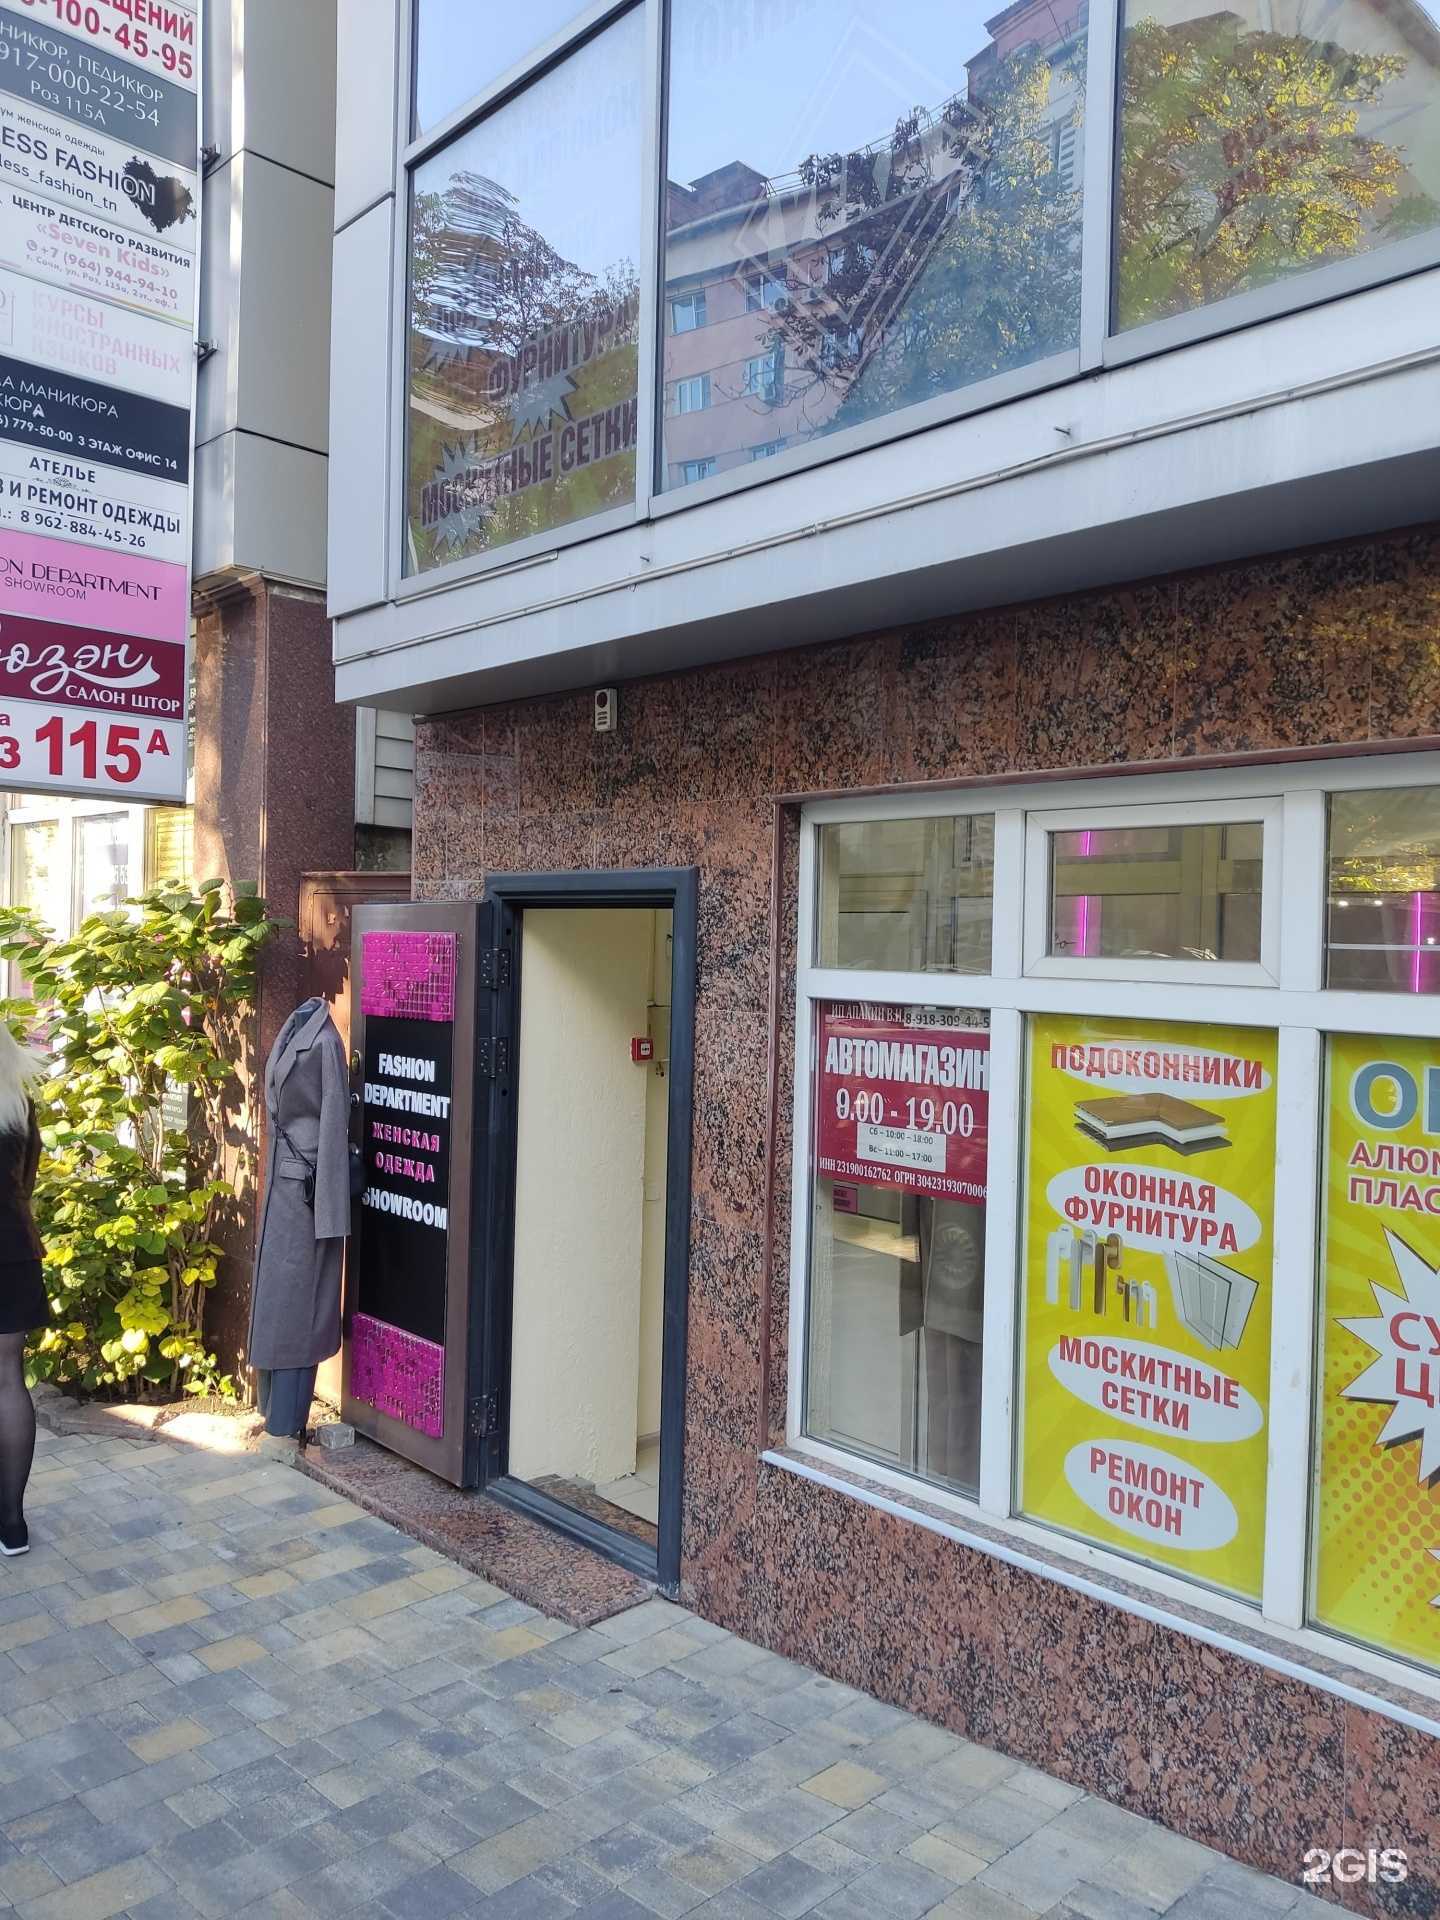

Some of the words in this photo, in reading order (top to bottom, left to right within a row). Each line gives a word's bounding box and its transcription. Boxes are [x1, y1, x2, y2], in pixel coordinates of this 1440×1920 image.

[22, 0, 192, 79] -100-45-95
[104, 0, 193, 45] ЩЕНИЙ
[79, 55, 163, 102] ПЕДИКЮР
[31, 80, 60, 104] Роз
[66, 96, 106, 125] 115А
[17, 114, 61, 137] женской
[65, 134, 105, 156] одежды
[55, 147, 156, 205] FASHION
[12, 194, 56, 218] ЦЕНТР
[59, 213, 125, 245] ДЕТСКОГО
[128, 238, 190, 269] РАЗВИТИЯ
[20, 380, 119, 419] МАНИКЮРА
[12, 417, 73, 442] 779-50-00
[78, 435, 86, 447] 3
[88, 438, 122, 456] ЭТАЖ
[125, 448, 162, 466] ОФИС
[164, 456, 178, 470] 14
[560, 397, 637, 474] СЕТКИ
[29, 456, 97, 484] АТЕЛЬЕ
[10, 480, 21, 498] И
[27, 484, 98, 515] РЕМОНТ
[102, 502, 181, 534] ОДЕЖДЫ
[20, 510, 30, 523] 8
[35, 512, 146, 548] 962-884-45-26
[4, 576, 87, 600] SHOWROOM
[32, 562, 163, 601] DEPARTMENT
[65, 685, 125, 706] САЛОН
[131, 693, 181, 713] ШТОР
[378, 1052, 435, 1082] FASHION
[825, 1037, 991, 1091] АВТОМАГАЗИН
[1051, 1042, 1262, 1089] ПОДОКОННИКИ
[364, 1083, 451, 1119] DEPARTMENT
[836, 1088, 884, 1124] 9.00
[905, 1096, 974, 1137] 19.00
[1352, 1061, 1440, 1135] О
[372, 1121, 440, 1153] ЖЕНСКАЯ
[375, 1151, 435, 1183] ОДЕЖДА
[894, 1170, 916, 1186] ОГРН
[1084, 1166, 1216, 1213] ОКОННАЯ
[1064, 1196, 1239, 1252] ФУРНИТУРА
[1059, 1335, 1239, 1409] МОСКИТНЫЕ
[1102, 1381, 1190, 1431] СЕТКИ
[1090, 1447, 1205, 1509] РЕМОНТ
[1108, 1486, 1182, 1537] ОКОН
